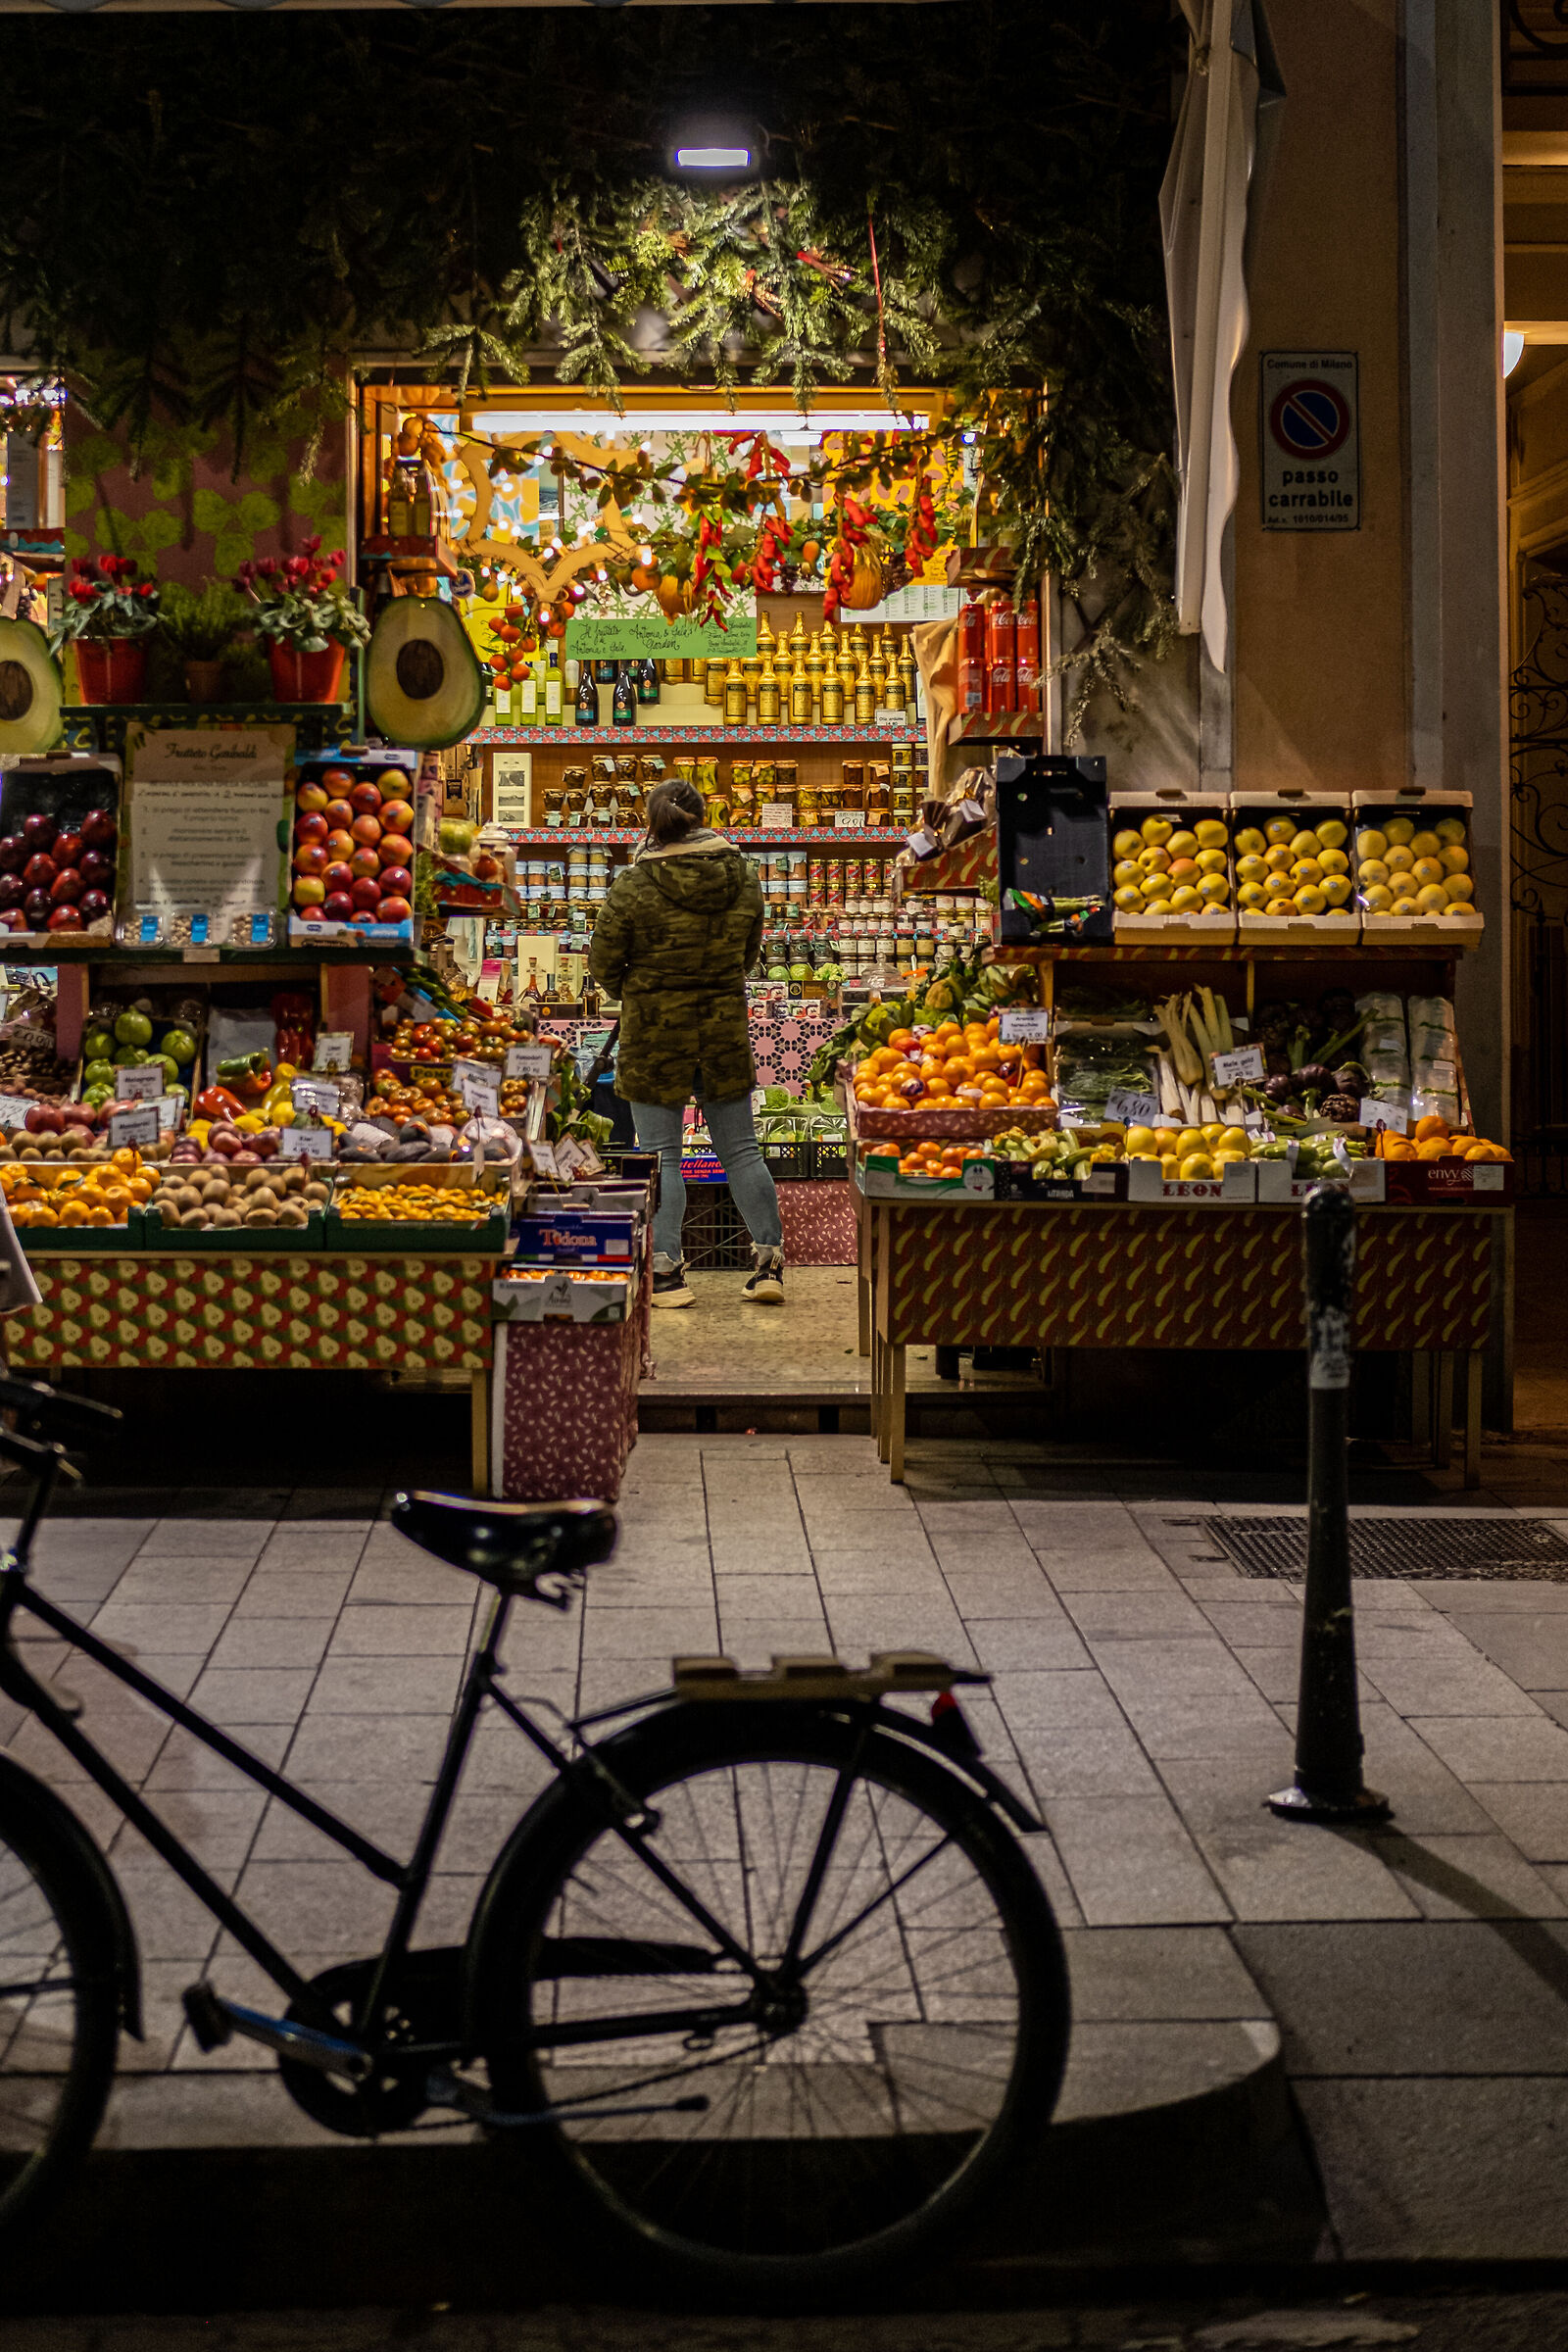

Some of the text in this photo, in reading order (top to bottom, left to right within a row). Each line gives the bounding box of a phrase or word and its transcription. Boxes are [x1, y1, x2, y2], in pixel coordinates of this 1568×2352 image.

[1267, 359, 1352, 369] Comune di Milano
[1283, 470, 1339, 486] passo
[1269, 490, 1352, 508] carrabile
[1428, 1168, 1462, 1187] envy
